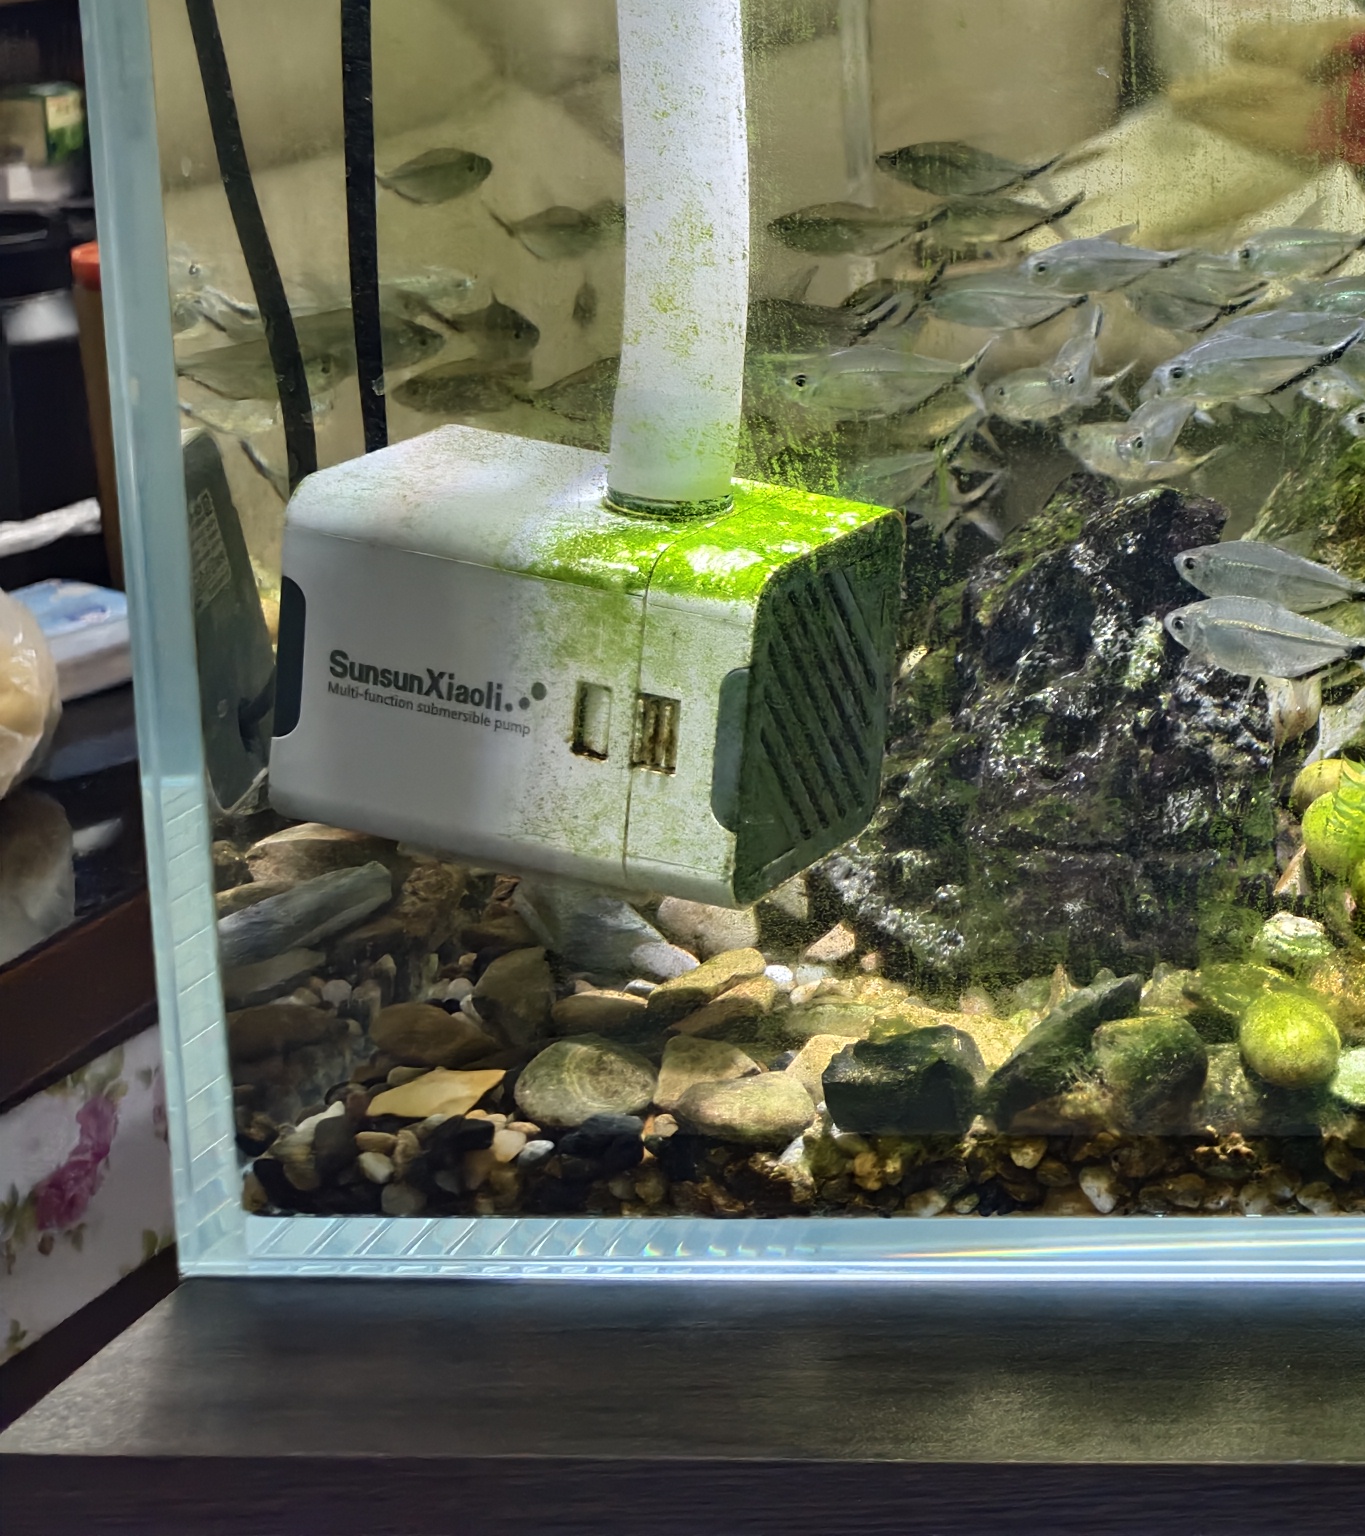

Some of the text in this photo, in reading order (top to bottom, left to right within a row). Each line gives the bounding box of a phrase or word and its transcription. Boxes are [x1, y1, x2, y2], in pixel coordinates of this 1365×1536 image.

[327, 680, 532, 738] Multi-function submersible pump
